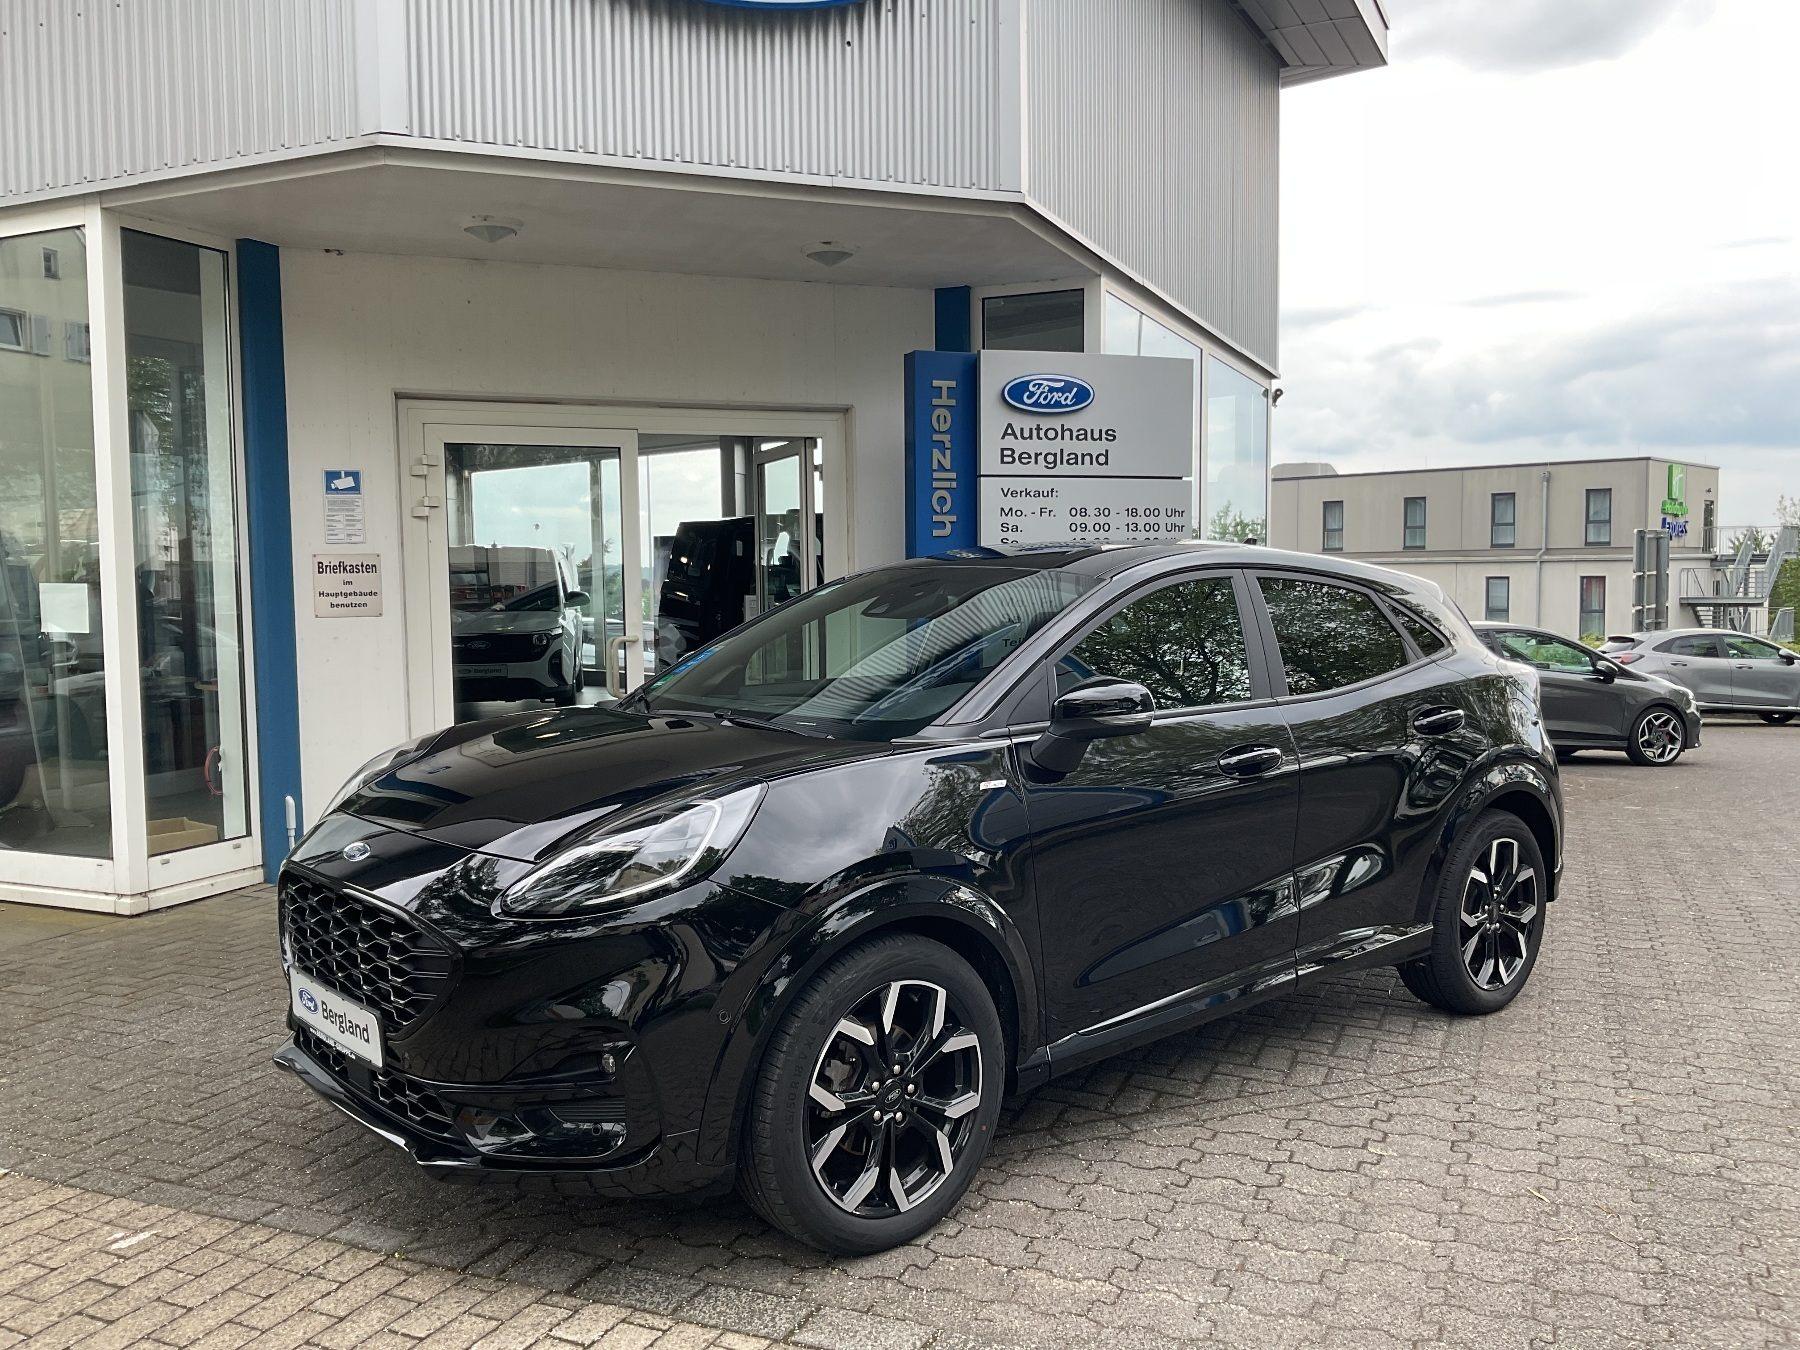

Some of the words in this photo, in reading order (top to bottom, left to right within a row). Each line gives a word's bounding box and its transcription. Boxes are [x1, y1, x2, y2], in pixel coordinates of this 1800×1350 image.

[1022, 379, 1079, 405] Ford
[1000, 422, 1117, 442] Autohaus
[931, 379, 957, 537] Herzlich
[1000, 447, 1109, 470] Bergland
[1000, 487, 1059, 498] Verkauf:
[1069, 507, 1111, 518] 08.30
[1124, 507, 1161, 518] 18.00
[1165, 507, 1186, 518] Uhr
[1000, 522, 1023, 533] Sa.
[1069, 522, 1111, 533] 09.00
[1124, 522, 1161, 533] 13.00
[1165, 522, 1186, 533] Uhr
[317, 561, 378, 575] Briefkasten
[318, 590, 378, 599] Hauptgebäude
[329, 601, 368, 609] benutzen
[321, 1000, 370, 1045] Bergland
